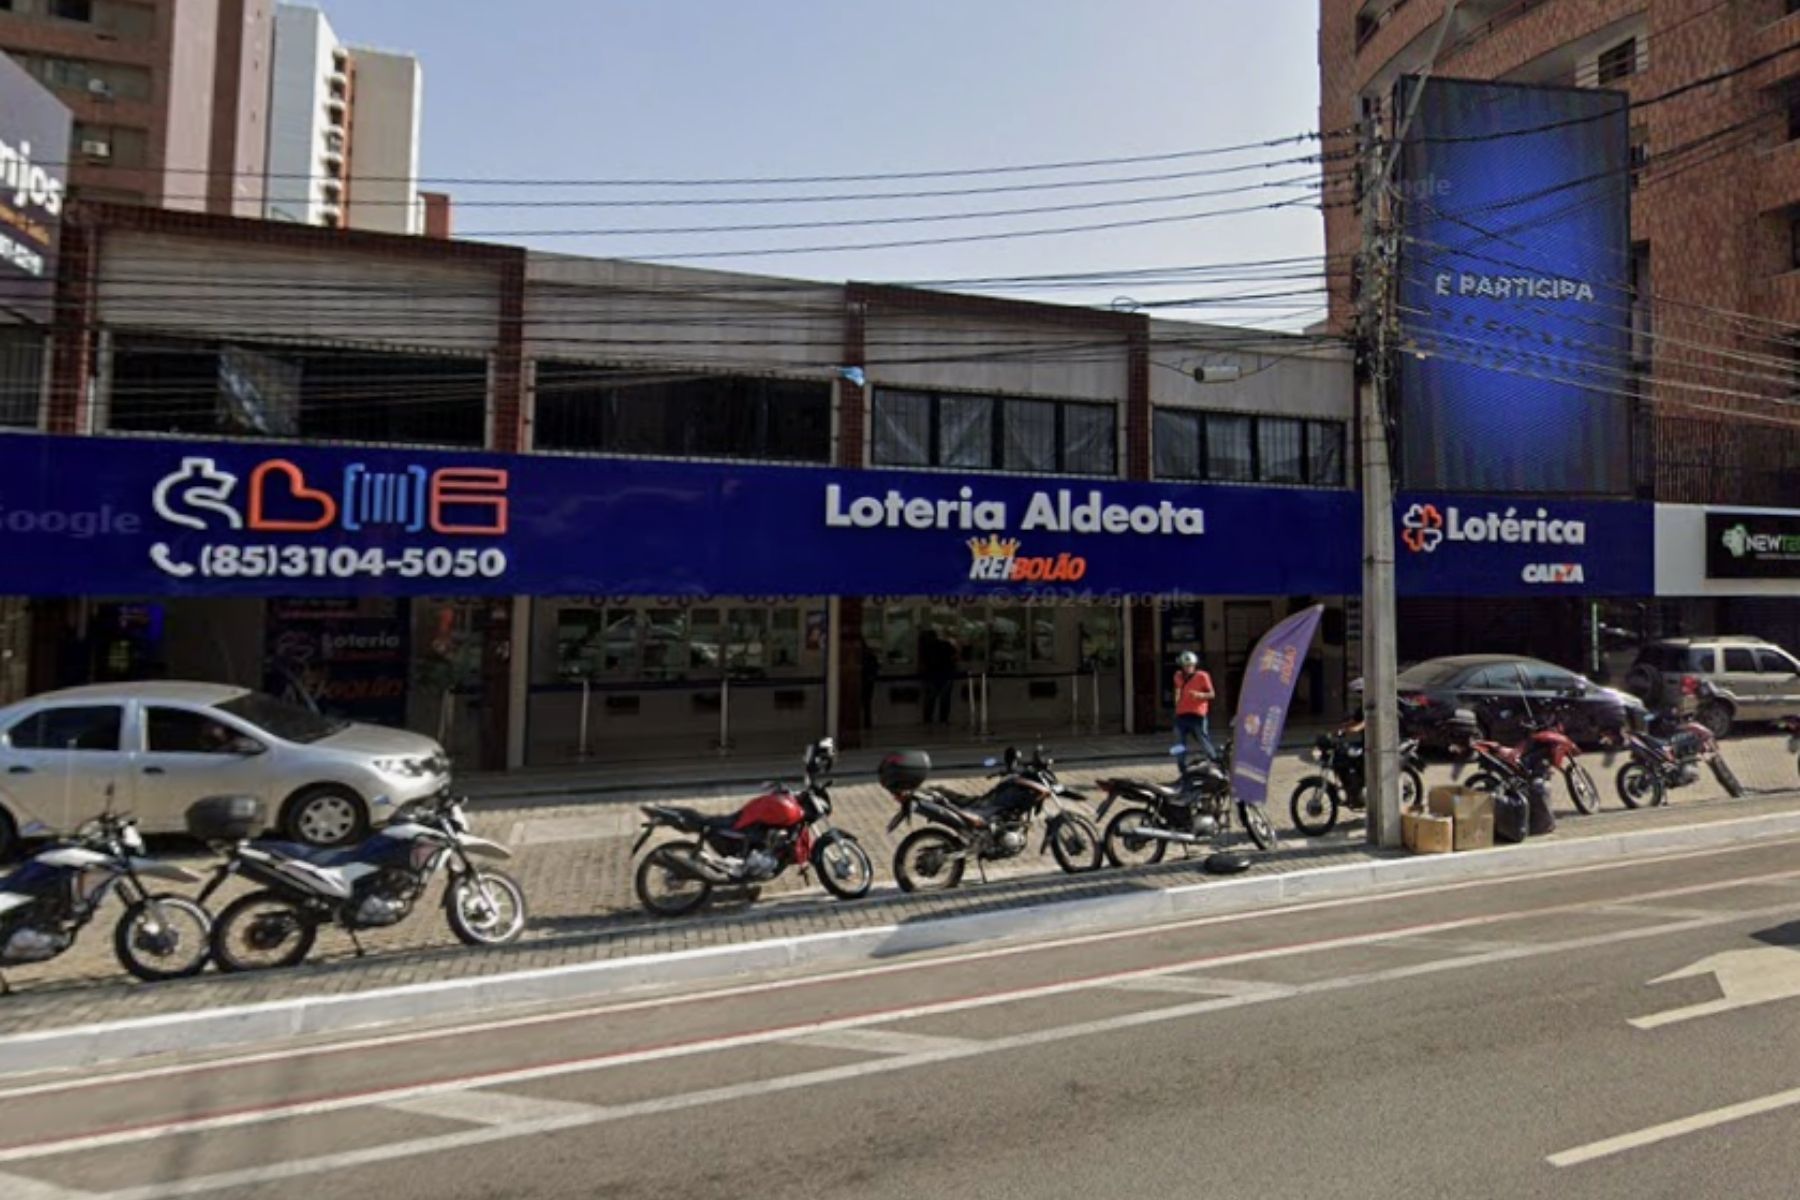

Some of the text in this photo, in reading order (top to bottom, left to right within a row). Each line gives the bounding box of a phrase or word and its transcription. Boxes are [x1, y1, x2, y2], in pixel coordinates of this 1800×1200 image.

[1460, 275, 1595, 302] PARTICIPA
[825, 484, 1204, 534] Loteria Aldeota
[1446, 506, 1586, 544] Lotérica
[201, 544, 507, 577] (85)3104-5050
[1521, 563, 1585, 584] CAIXA
